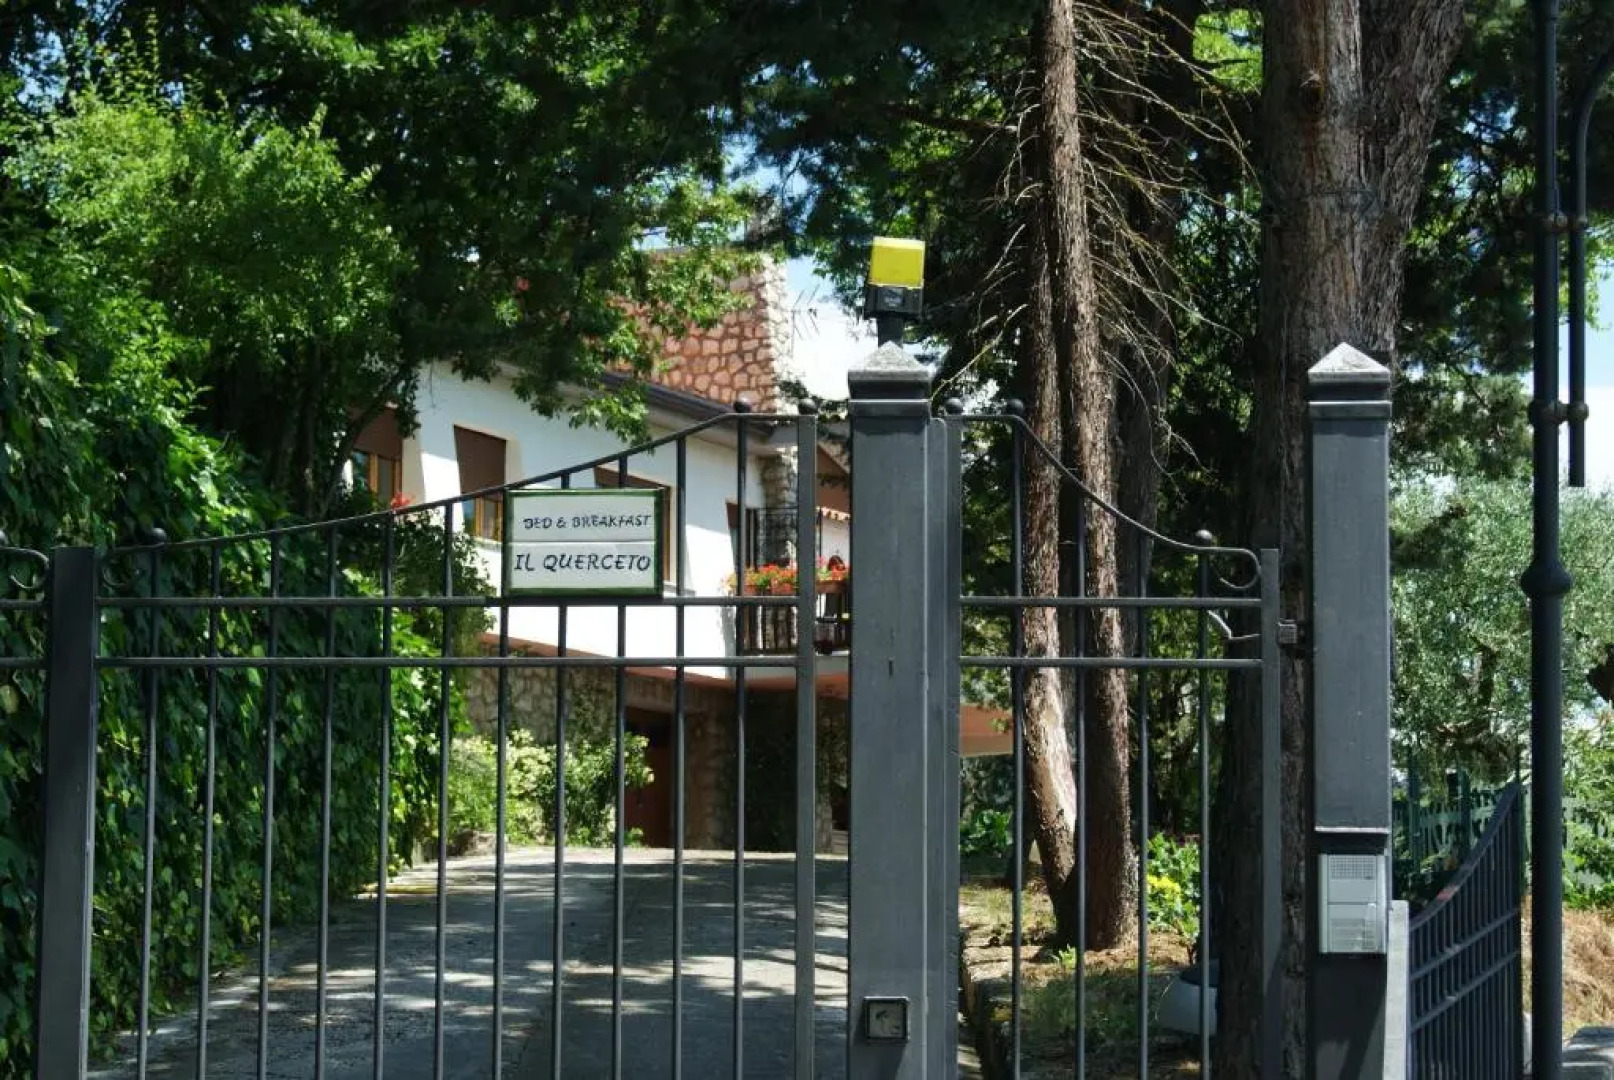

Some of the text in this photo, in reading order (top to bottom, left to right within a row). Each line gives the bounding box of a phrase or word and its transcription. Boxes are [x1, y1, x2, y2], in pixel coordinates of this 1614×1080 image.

[523, 514, 652, 529] BED & BREAKFAST
[514, 553, 651, 573] IL QUERCETO
